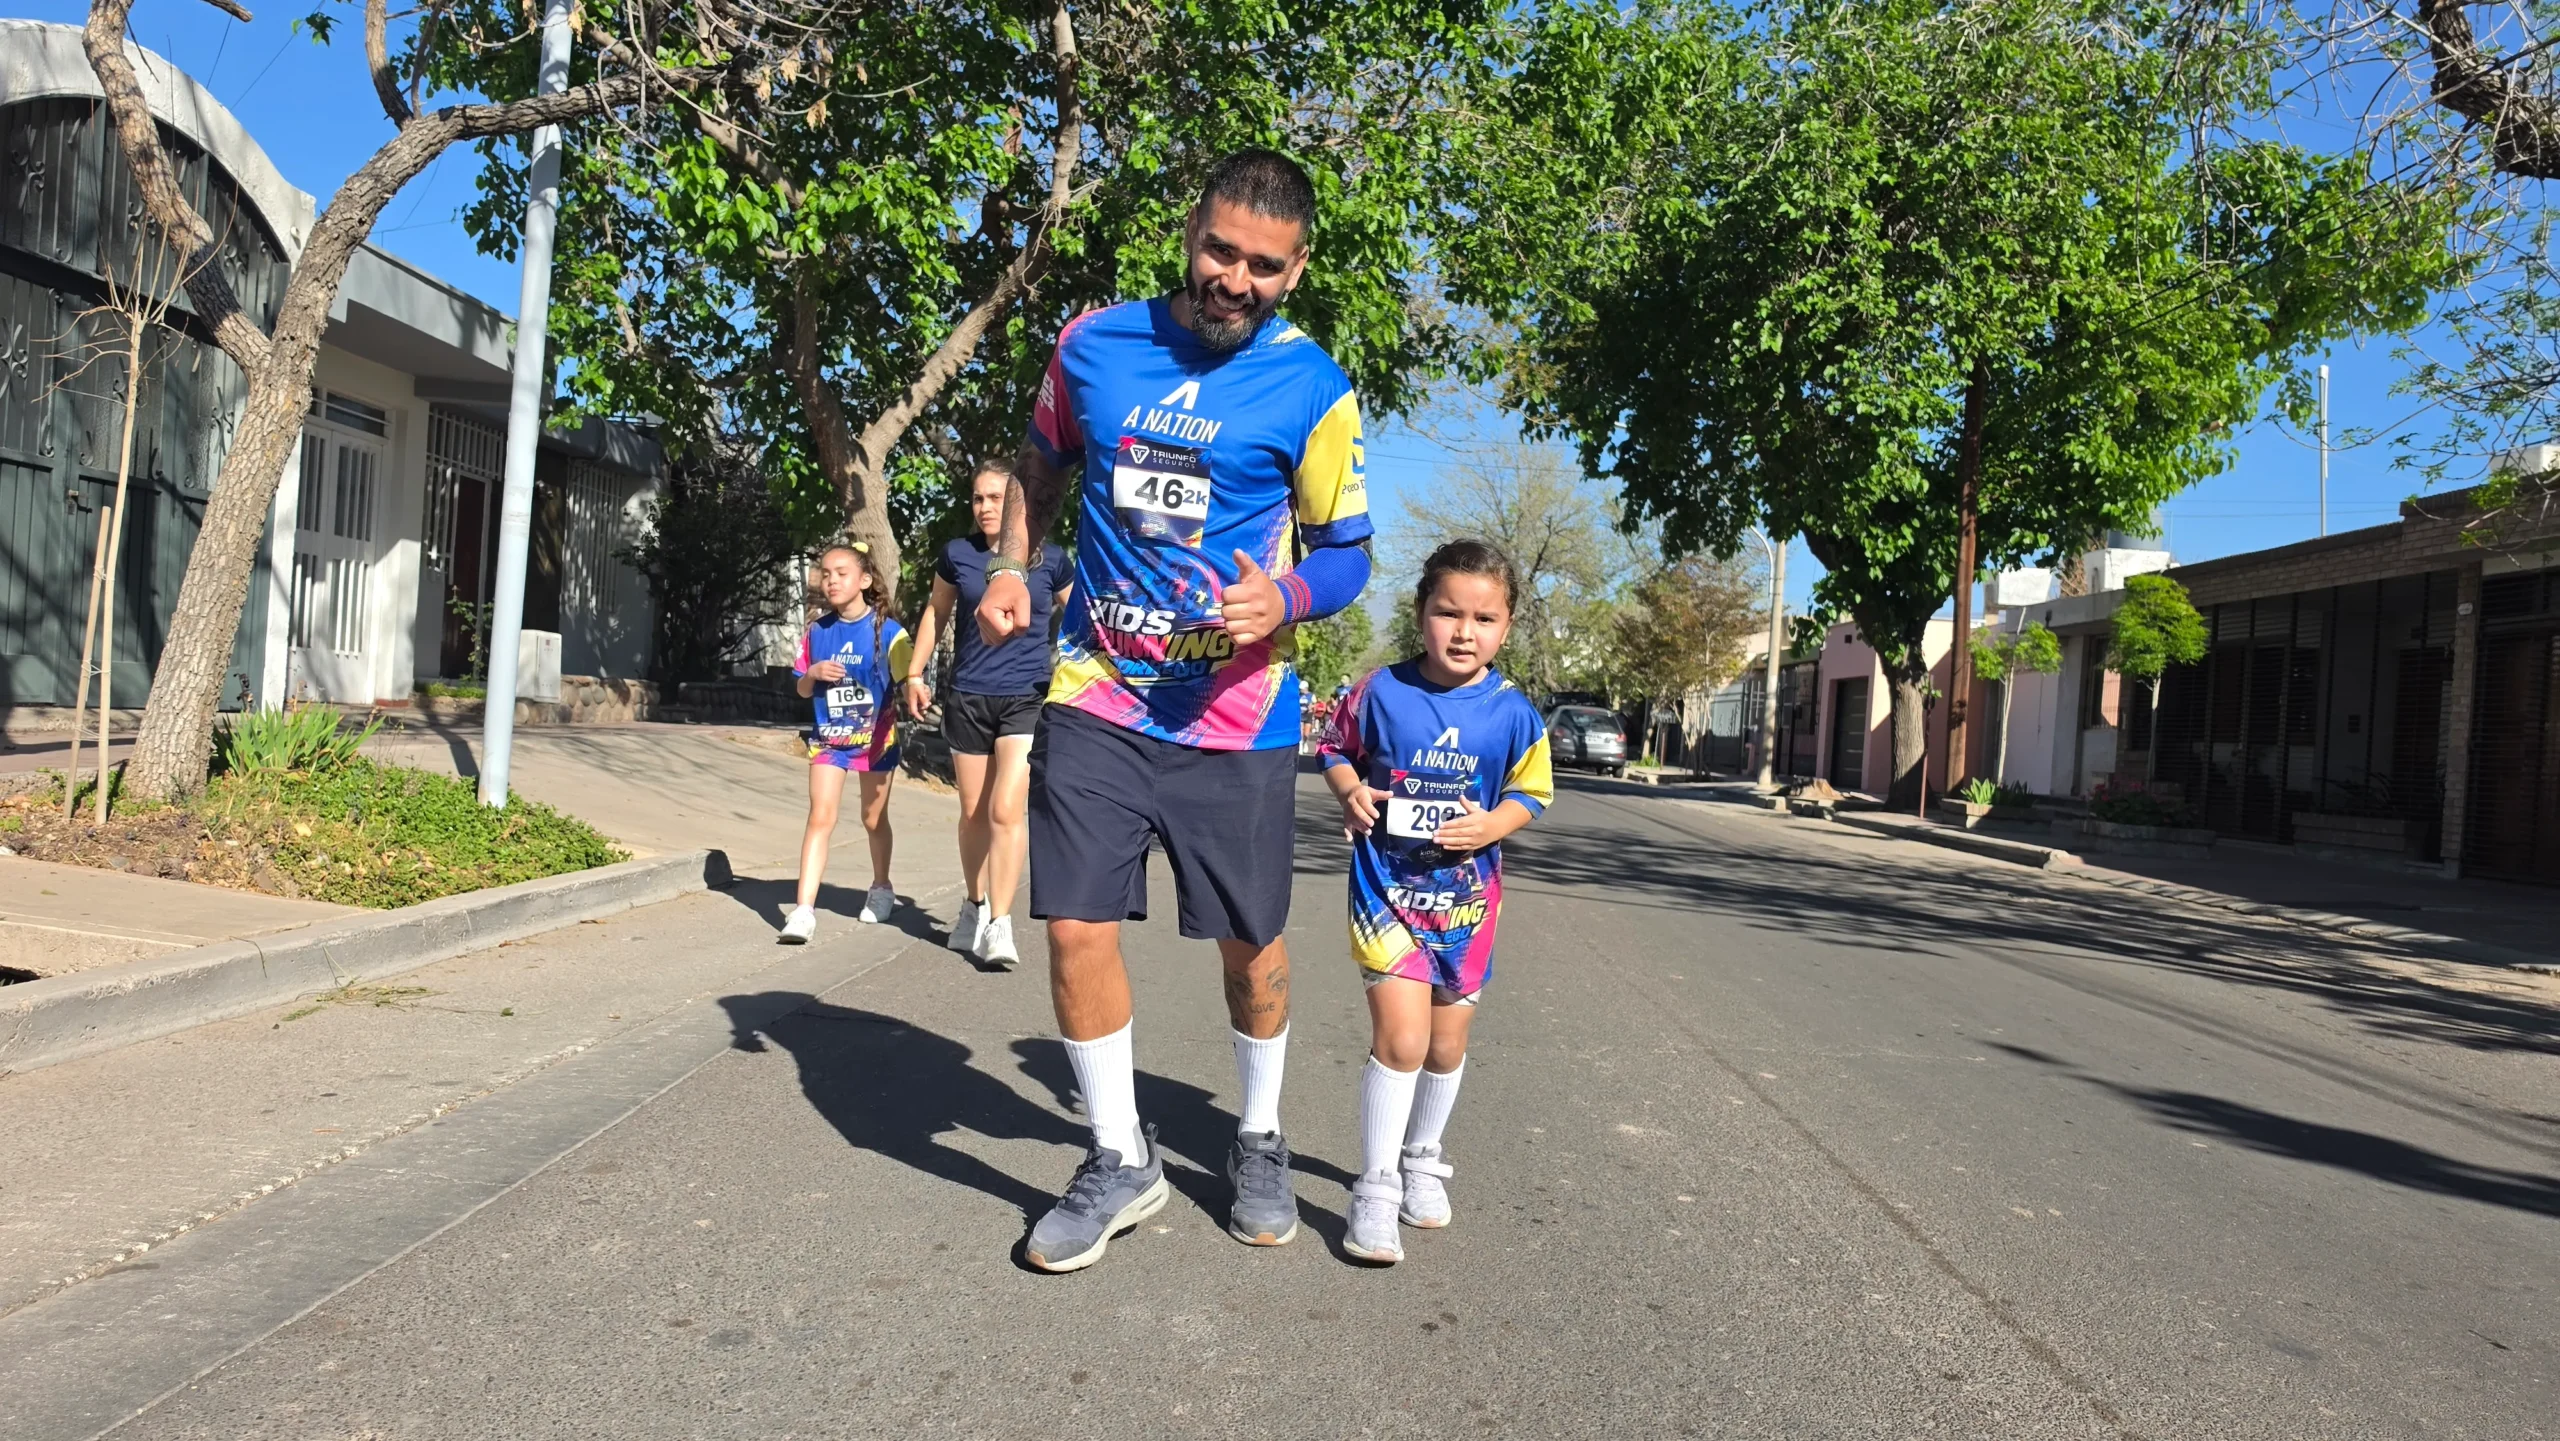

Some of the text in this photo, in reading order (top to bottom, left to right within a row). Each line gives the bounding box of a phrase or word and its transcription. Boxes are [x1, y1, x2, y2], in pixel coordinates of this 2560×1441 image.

[1122, 405, 1222, 443] A NATION
[1152, 449, 1196, 463] TRIUNFO
[1152, 457, 1195, 469] SEGUROS
[1134, 476, 1184, 509] 46
[1090, 599, 1175, 635] KIDS
[836, 655, 863, 665] NATION
[835, 688, 865, 703] 160
[1411, 749, 1479, 773] A NATION
[1424, 781, 1466, 790] TRIUNFO
[1425, 788, 1465, 796] SEGUROS
[1387, 887, 1455, 911] KIDS
